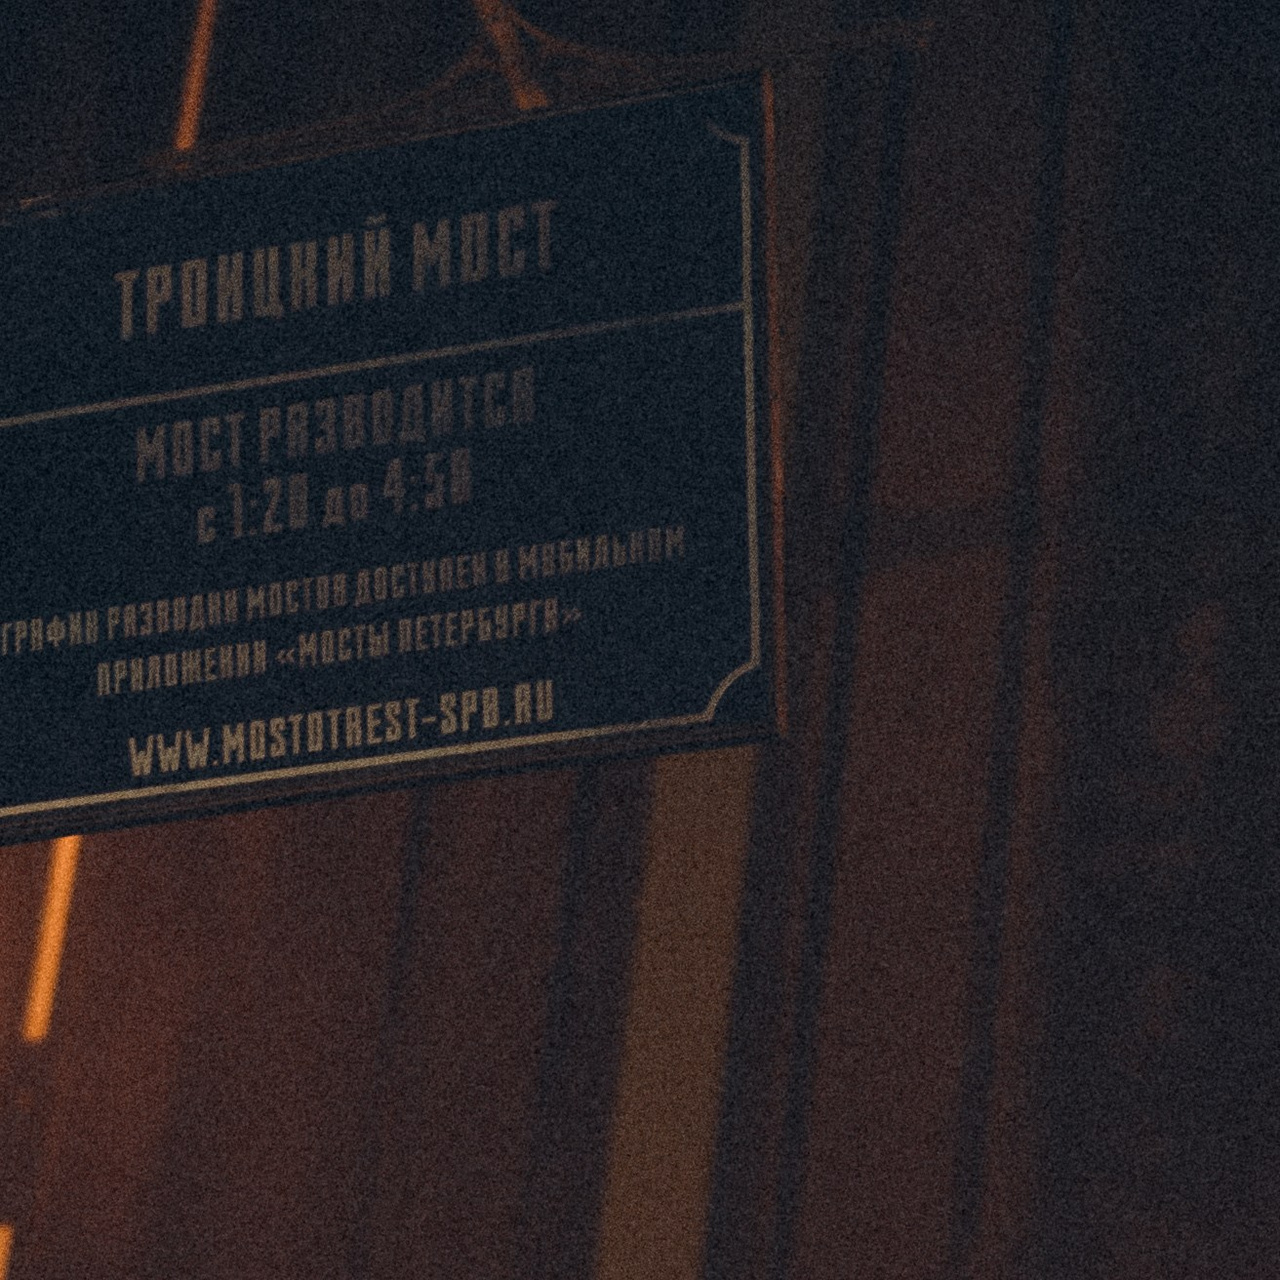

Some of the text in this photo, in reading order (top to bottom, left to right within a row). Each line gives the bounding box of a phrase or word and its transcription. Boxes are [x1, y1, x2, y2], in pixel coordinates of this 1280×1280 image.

[113, 199, 558, 341] ТРОИЦКИЙ МОСТ
[135, 366, 536, 483] МОСТ РАЗВОДИТСЯ
[228, 472, 309, 539] 1:20
[321, 482, 370, 528] до
[382, 447, 472, 514] 4:50
[0, 525, 686, 656] ГРАФИК РАЗВОДКИ МОСТОВ ДОСТУПЕН В МОБИЛЬНОМ
[96, 597, 583, 697] ПРИЛОЖЕНИИ «МОСТЫ ПЕТЕРБУРГА»
[128, 679, 555, 777] WWW.MOSTOTREST-SPB.RU
